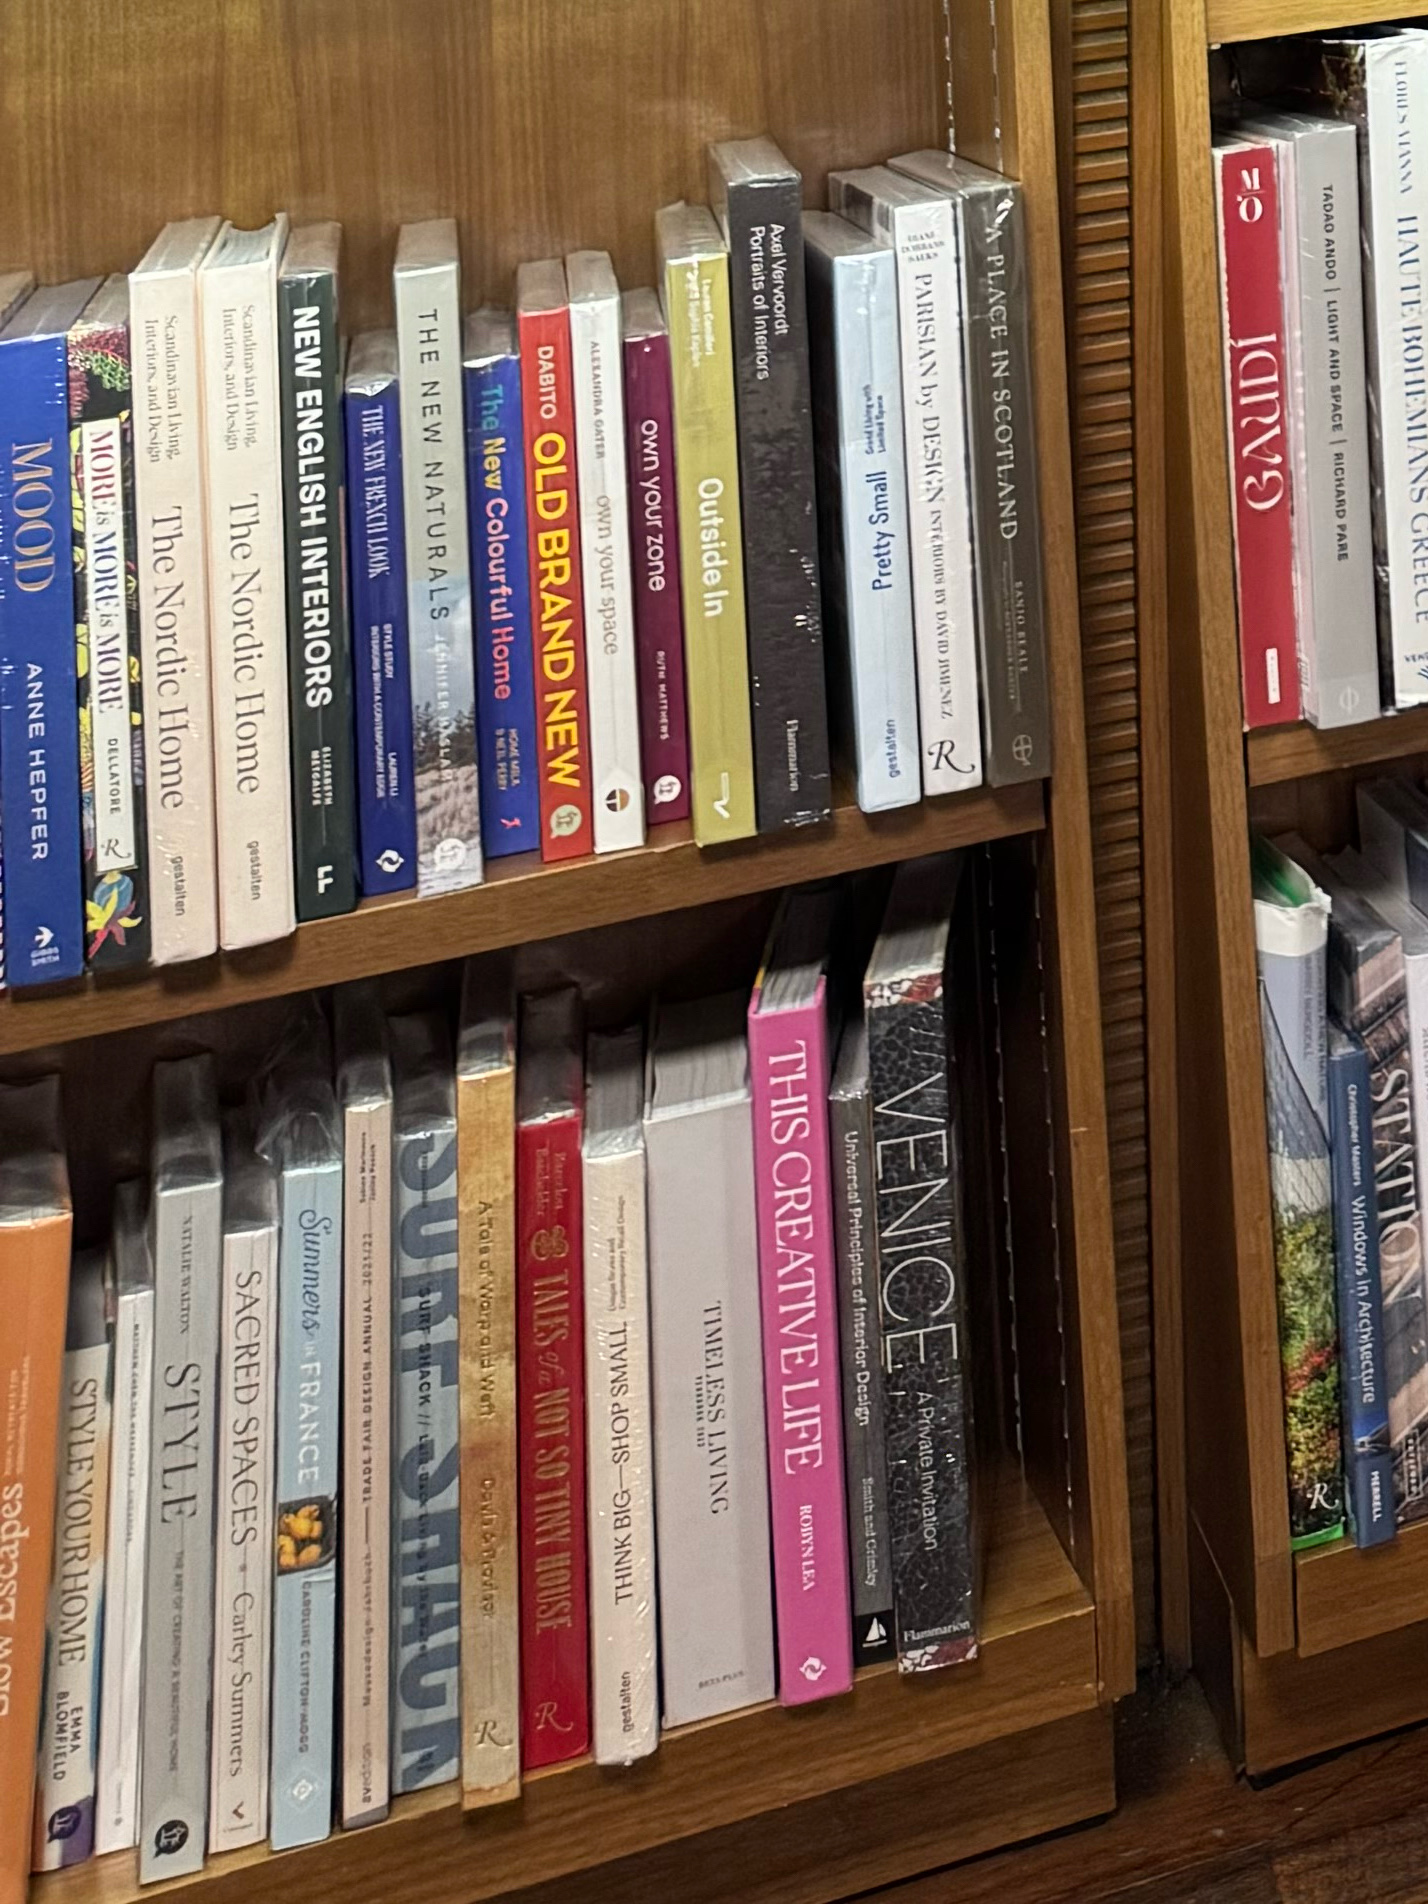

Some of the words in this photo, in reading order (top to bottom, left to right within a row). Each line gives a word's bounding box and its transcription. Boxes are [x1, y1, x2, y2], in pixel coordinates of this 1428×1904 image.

[293, 305, 324, 378] NEW
[985, 253, 1010, 340] PLACE
[537, 345, 558, 421] DABITO
[991, 344, 1011, 380] IN
[295, 390, 328, 520] ENGLISH
[533, 431, 569, 522] OLD
[868, 469, 890, 525] Small
[992, 387, 1018, 540] SCOTLAND
[11, 438, 57, 592] MOOD
[229, 493, 259, 564] The
[698, 478, 728, 584] Outside
[872, 525, 898, 591] Pretty
[231, 567, 265, 682] Nordic
[299, 526, 334, 709] INTERIORS
[536, 528, 576, 682] BRAND
[704, 589, 724, 619] In
[233, 690, 266, 794] Home
[544, 689, 582, 789] NEW
[769, 1039, 808, 1145] THIS
[770, 1152, 821, 1376] CREATIVE
[873, 1071, 958, 1375] VENICE
[234, 1270, 263, 1406] SACRED
[161, 1362, 202, 1524] STYLE
[781, 1379, 824, 1476] LIFE
[230, 1417, 259, 1547] SPACES
